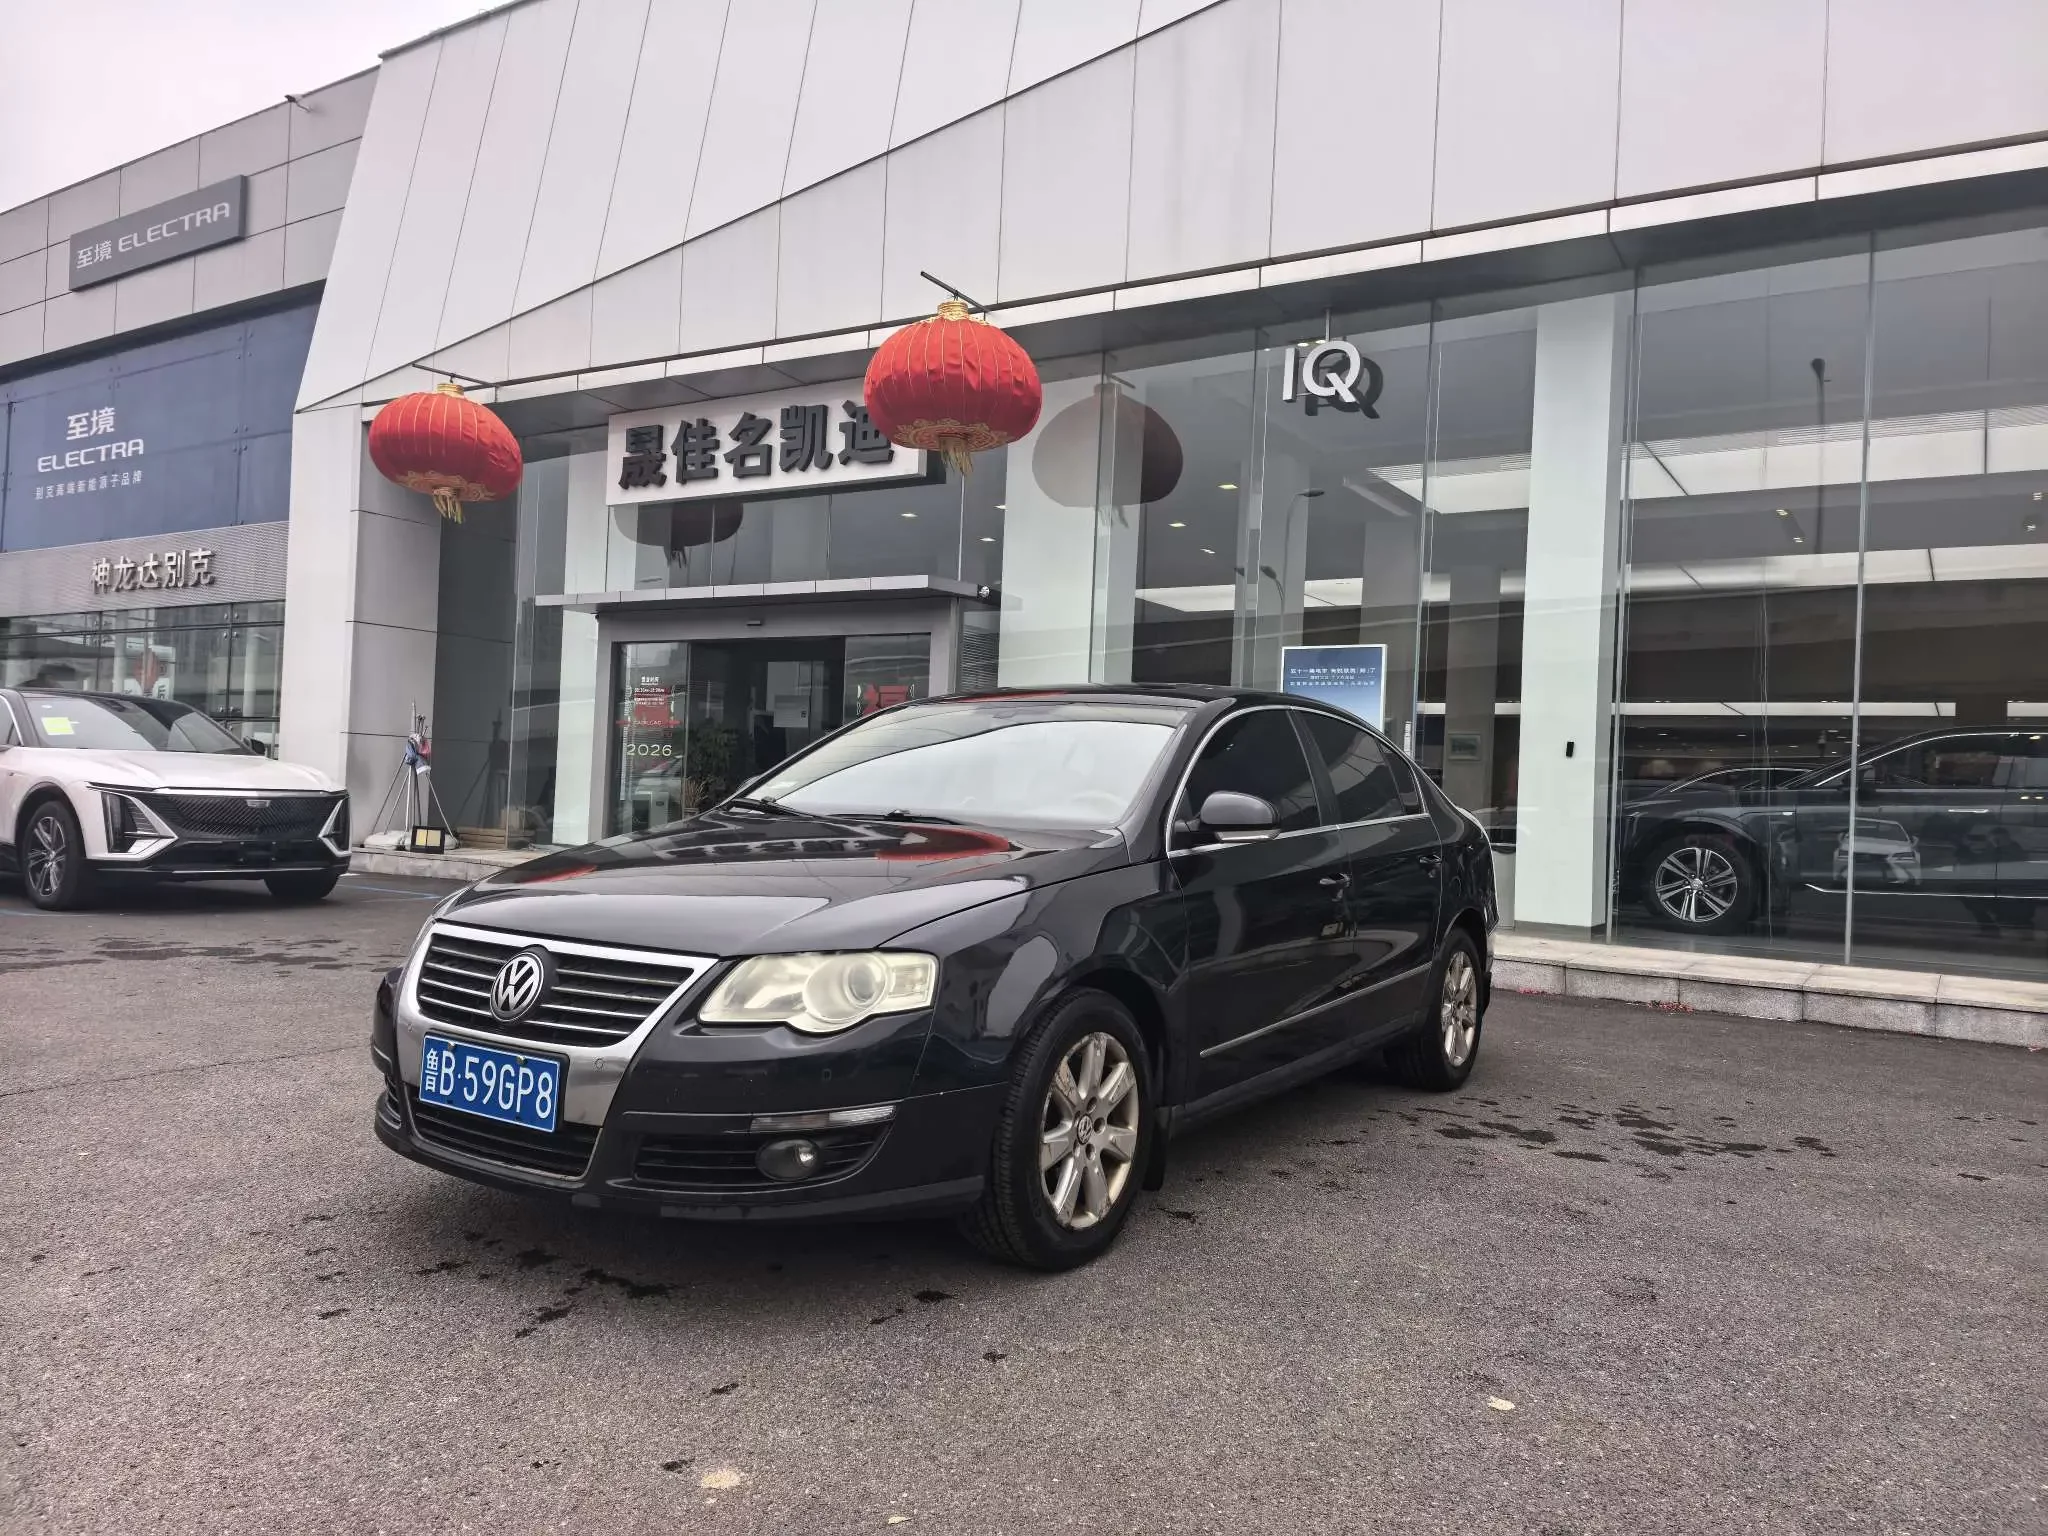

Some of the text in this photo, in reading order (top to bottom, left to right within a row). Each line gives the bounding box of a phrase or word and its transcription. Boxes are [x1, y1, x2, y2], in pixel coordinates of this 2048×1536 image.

[76, 202, 230, 269] 至境 ELECTRA
[1283, 341, 1361, 403] IQ
[66, 406, 116, 440] 至境
[618, 400, 894, 489] 晟佳名凯迪
[37, 439, 144, 473] ELECTRA
[92, 548, 213, 593] 神龙达别克
[627, 744, 672, 756] 2026
